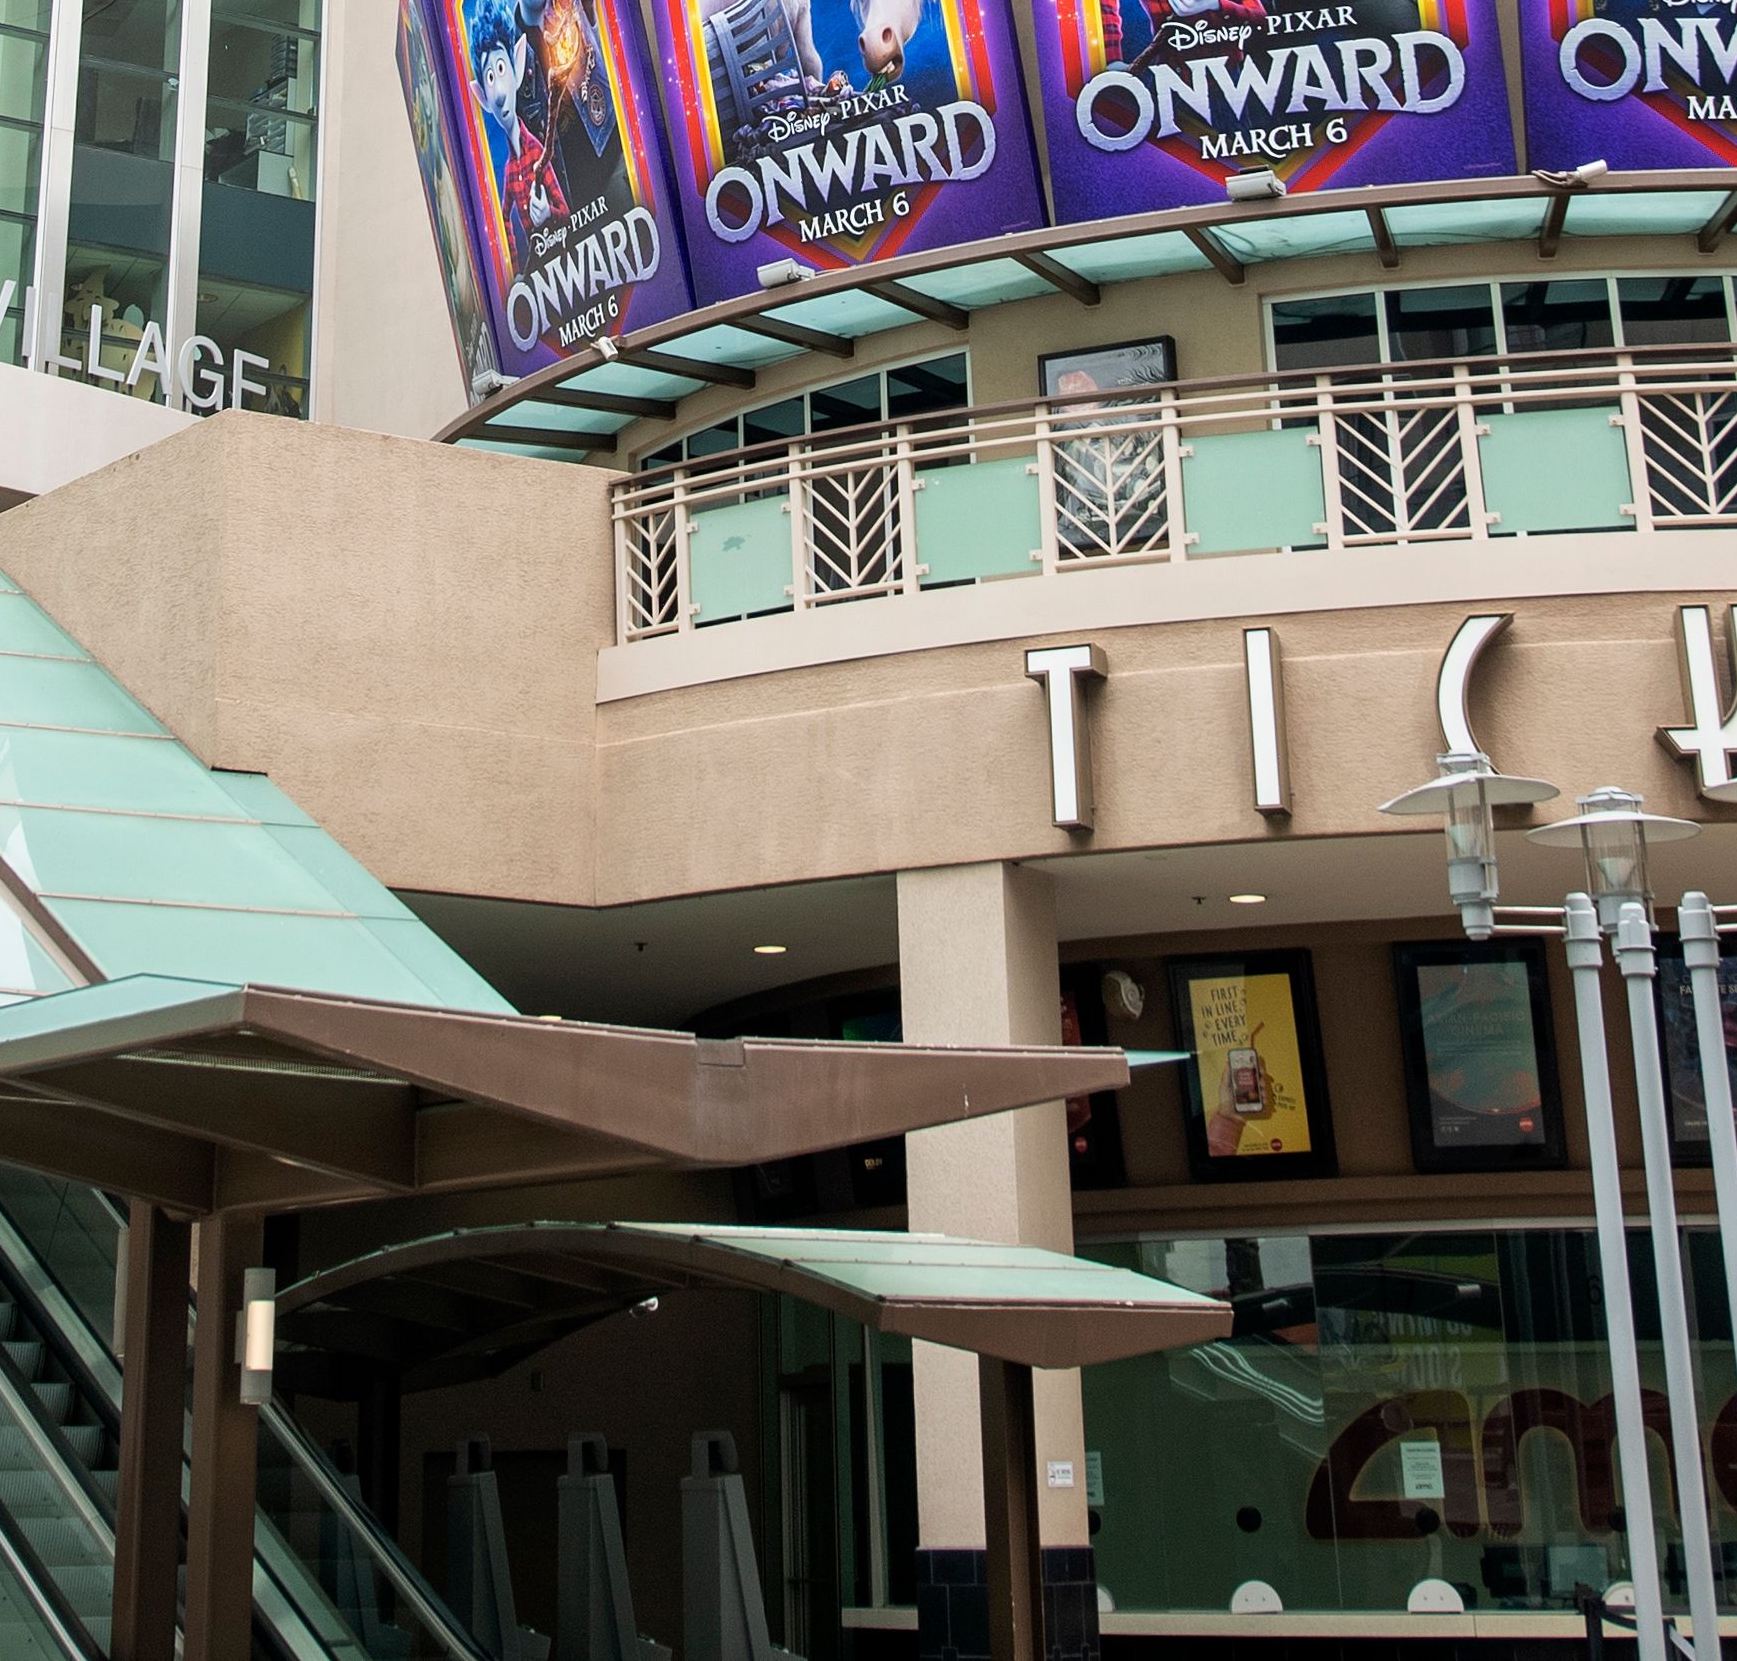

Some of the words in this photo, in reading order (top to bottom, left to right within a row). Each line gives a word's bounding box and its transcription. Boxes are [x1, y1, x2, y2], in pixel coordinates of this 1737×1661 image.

[1266, 6, 1358, 36] PIXAR
[840, 84, 909, 120] PIXAR
[1076, 30, 1465, 152] ONWARD
[1200, 122, 1312, 159] MARCH
[1325, 118, 1348, 144] 6
[706, 101, 997, 242] ONWARD
[570, 196, 609, 232] PIXAR
[799, 200, 884, 242] MARCH
[892, 191, 910, 217] 6
[507, 206, 660, 352] ONWARD
[558, 306, 605, 347] MARCH
[608, 295, 619, 318] 6
[1201, 1005, 1213, 1019] IN
[1210, 986, 1238, 1002] FIRST
[1215, 1014, 1246, 1031] EVERY
[1587, 1275, 1601, 1305] 6
